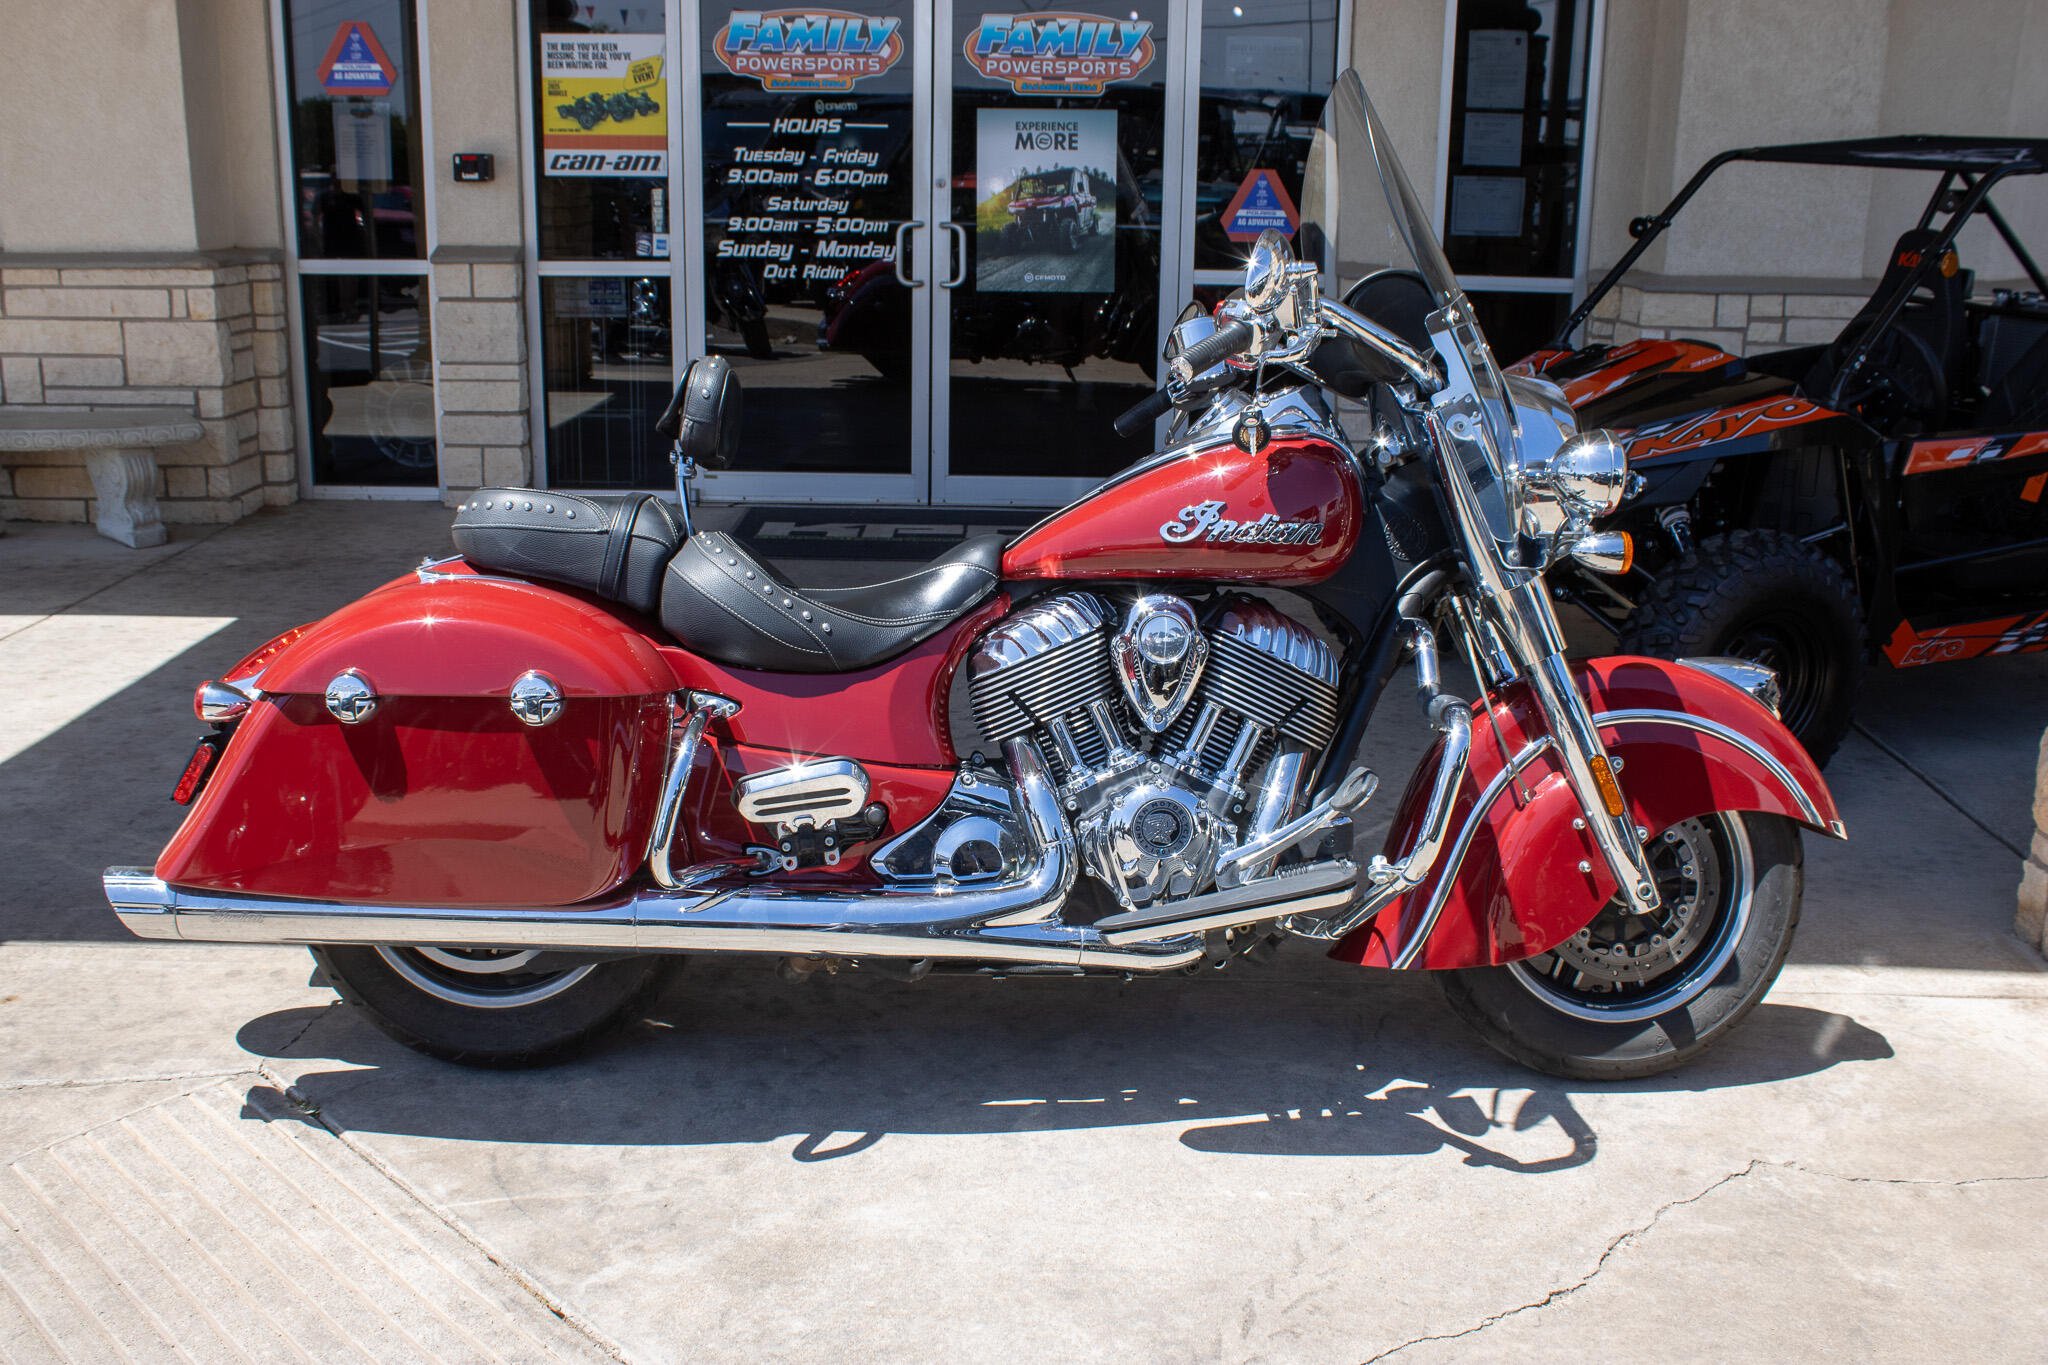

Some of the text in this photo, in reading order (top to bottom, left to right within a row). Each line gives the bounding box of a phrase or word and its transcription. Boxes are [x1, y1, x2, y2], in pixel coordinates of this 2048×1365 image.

[724, 11, 901, 54] FAMILY
[975, 14, 1153, 57] FAMILY
[547, 42, 558, 51] THE
[561, 42, 575, 51] RIDE
[601, 42, 618, 51] BEEN
[578, 52, 589, 60] THE
[592, 52, 607, 60] DEAL
[736, 57, 881, 72] POWERSPORTS
[547, 61, 564, 69] BEEN
[565, 61, 593, 69] WAITING
[986, 59, 1131, 75] POWERSPORTS
[633, 71, 655, 84] EVENT
[773, 118, 842, 134] HOURS
[1015, 121, 1079, 131] EXPERIENCE
[1015, 132, 1079, 151] MORE
[550, 154, 662, 171] can-am
[733, 147, 805, 166] Tuesday
[823, 148, 879, 167] Friday
[728, 168, 799, 184] 9:00am
[814, 168, 889, 187] 6:00pm
[767, 197, 849, 215] Saturday
[728, 216, 799, 232] 9:00am
[814, 216, 889, 235] 5:00pm
[1237, 218, 1285, 227] AG ADVANTAGE
[717, 240, 794, 261] Sunday
[816, 240, 897, 262] Monday
[763, 264, 849, 279] Out Ridin'
[1627, 399, 1820, 460] KAYO
[1159, 499, 1326, 546] Indian
